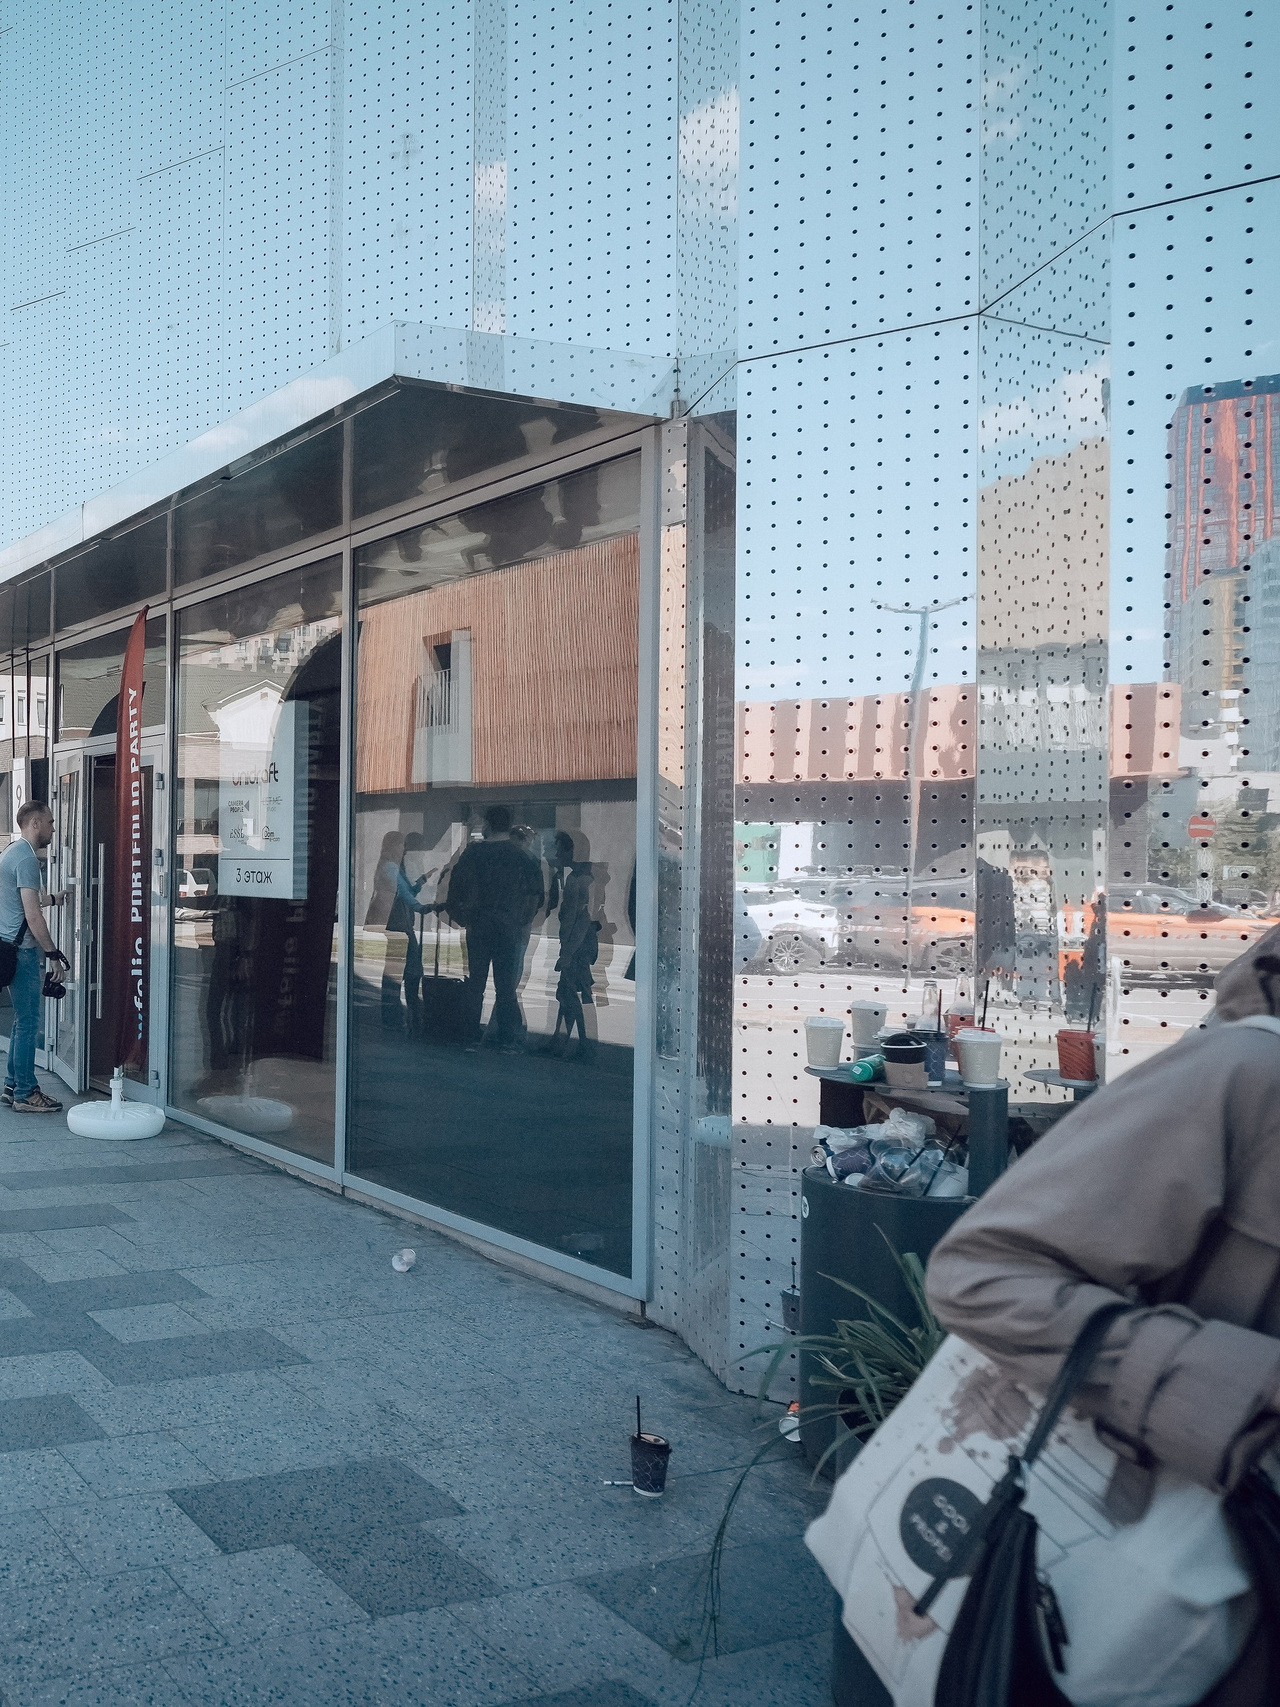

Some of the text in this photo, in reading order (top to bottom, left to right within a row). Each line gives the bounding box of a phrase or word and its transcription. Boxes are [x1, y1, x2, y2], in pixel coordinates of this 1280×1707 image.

[129, 688, 139, 773] PARTY
[232, 762, 279, 786] unidraft
[236, 868, 272, 884] 3 этаж
